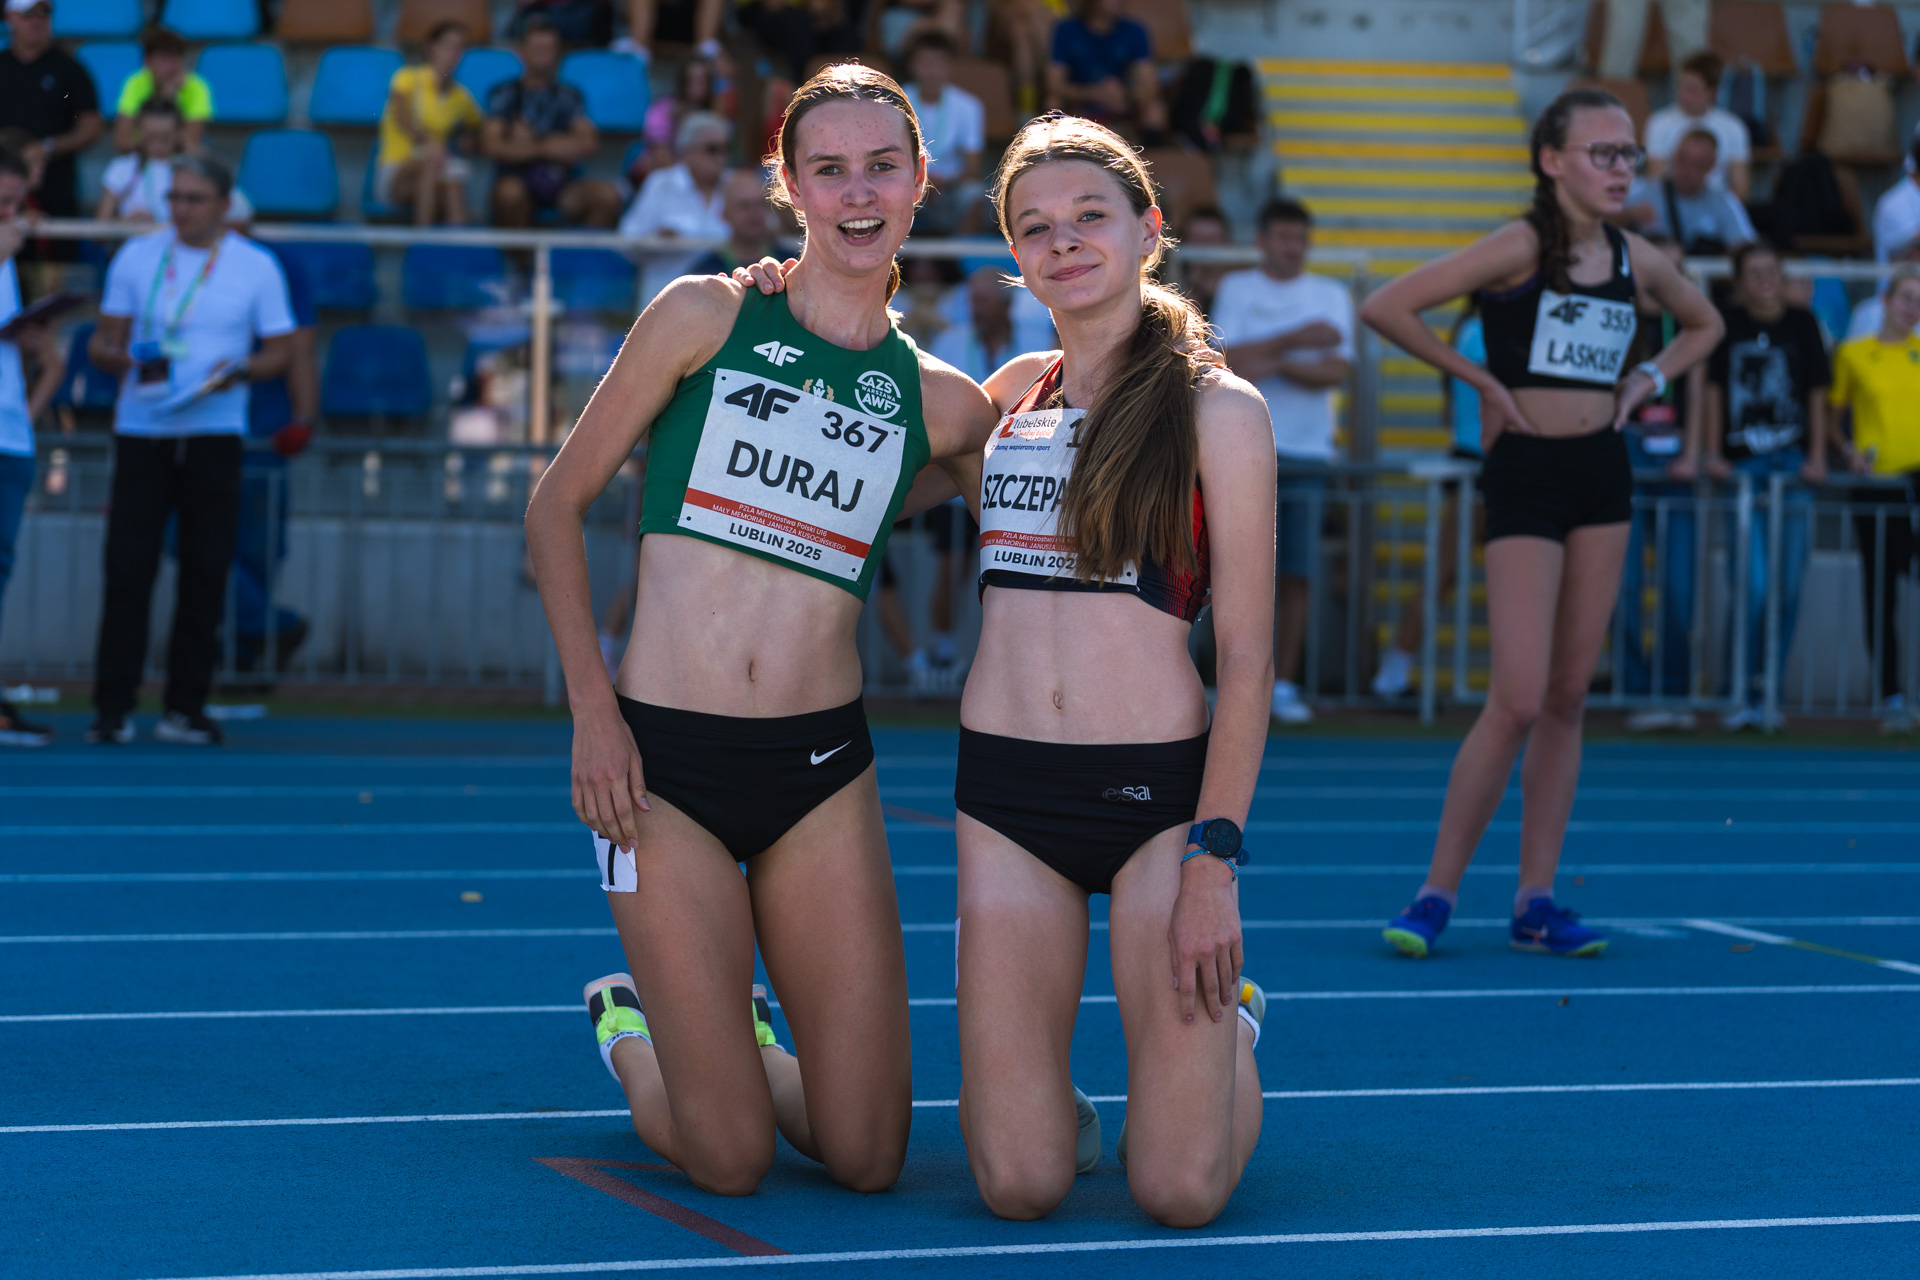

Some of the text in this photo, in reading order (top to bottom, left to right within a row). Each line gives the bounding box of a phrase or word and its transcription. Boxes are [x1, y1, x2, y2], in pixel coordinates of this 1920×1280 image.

[1548, 299, 1589, 324] 4F
[753, 341, 804, 367] 4F
[1547, 339, 1621, 373] LASKUS
[861, 385, 896, 402] WARSZAWA
[866, 376, 893, 394] AZS
[862, 393, 895, 412] AWF
[724, 382, 889, 453] 4F 367
[1013, 417, 1057, 429] lubelskie
[1036, 444, 1051, 452] sport
[726, 439, 865, 513] DURAJ
[712, 504, 846, 552] MAŁY MEMORIAŁ JANUSZA KUSOCIŃSKIEGO
[739, 504, 828, 537] PZLA Mistrzostwa Polski U16
[729, 522, 823, 561] LUBLIN 2025
[995, 538, 1028, 549] MEMORIAŁ
[1029, 542, 1056, 551] JANUSZA
[1002, 531, 1018, 540] PZLA
[994, 550, 1076, 570] LUBLIN 202
